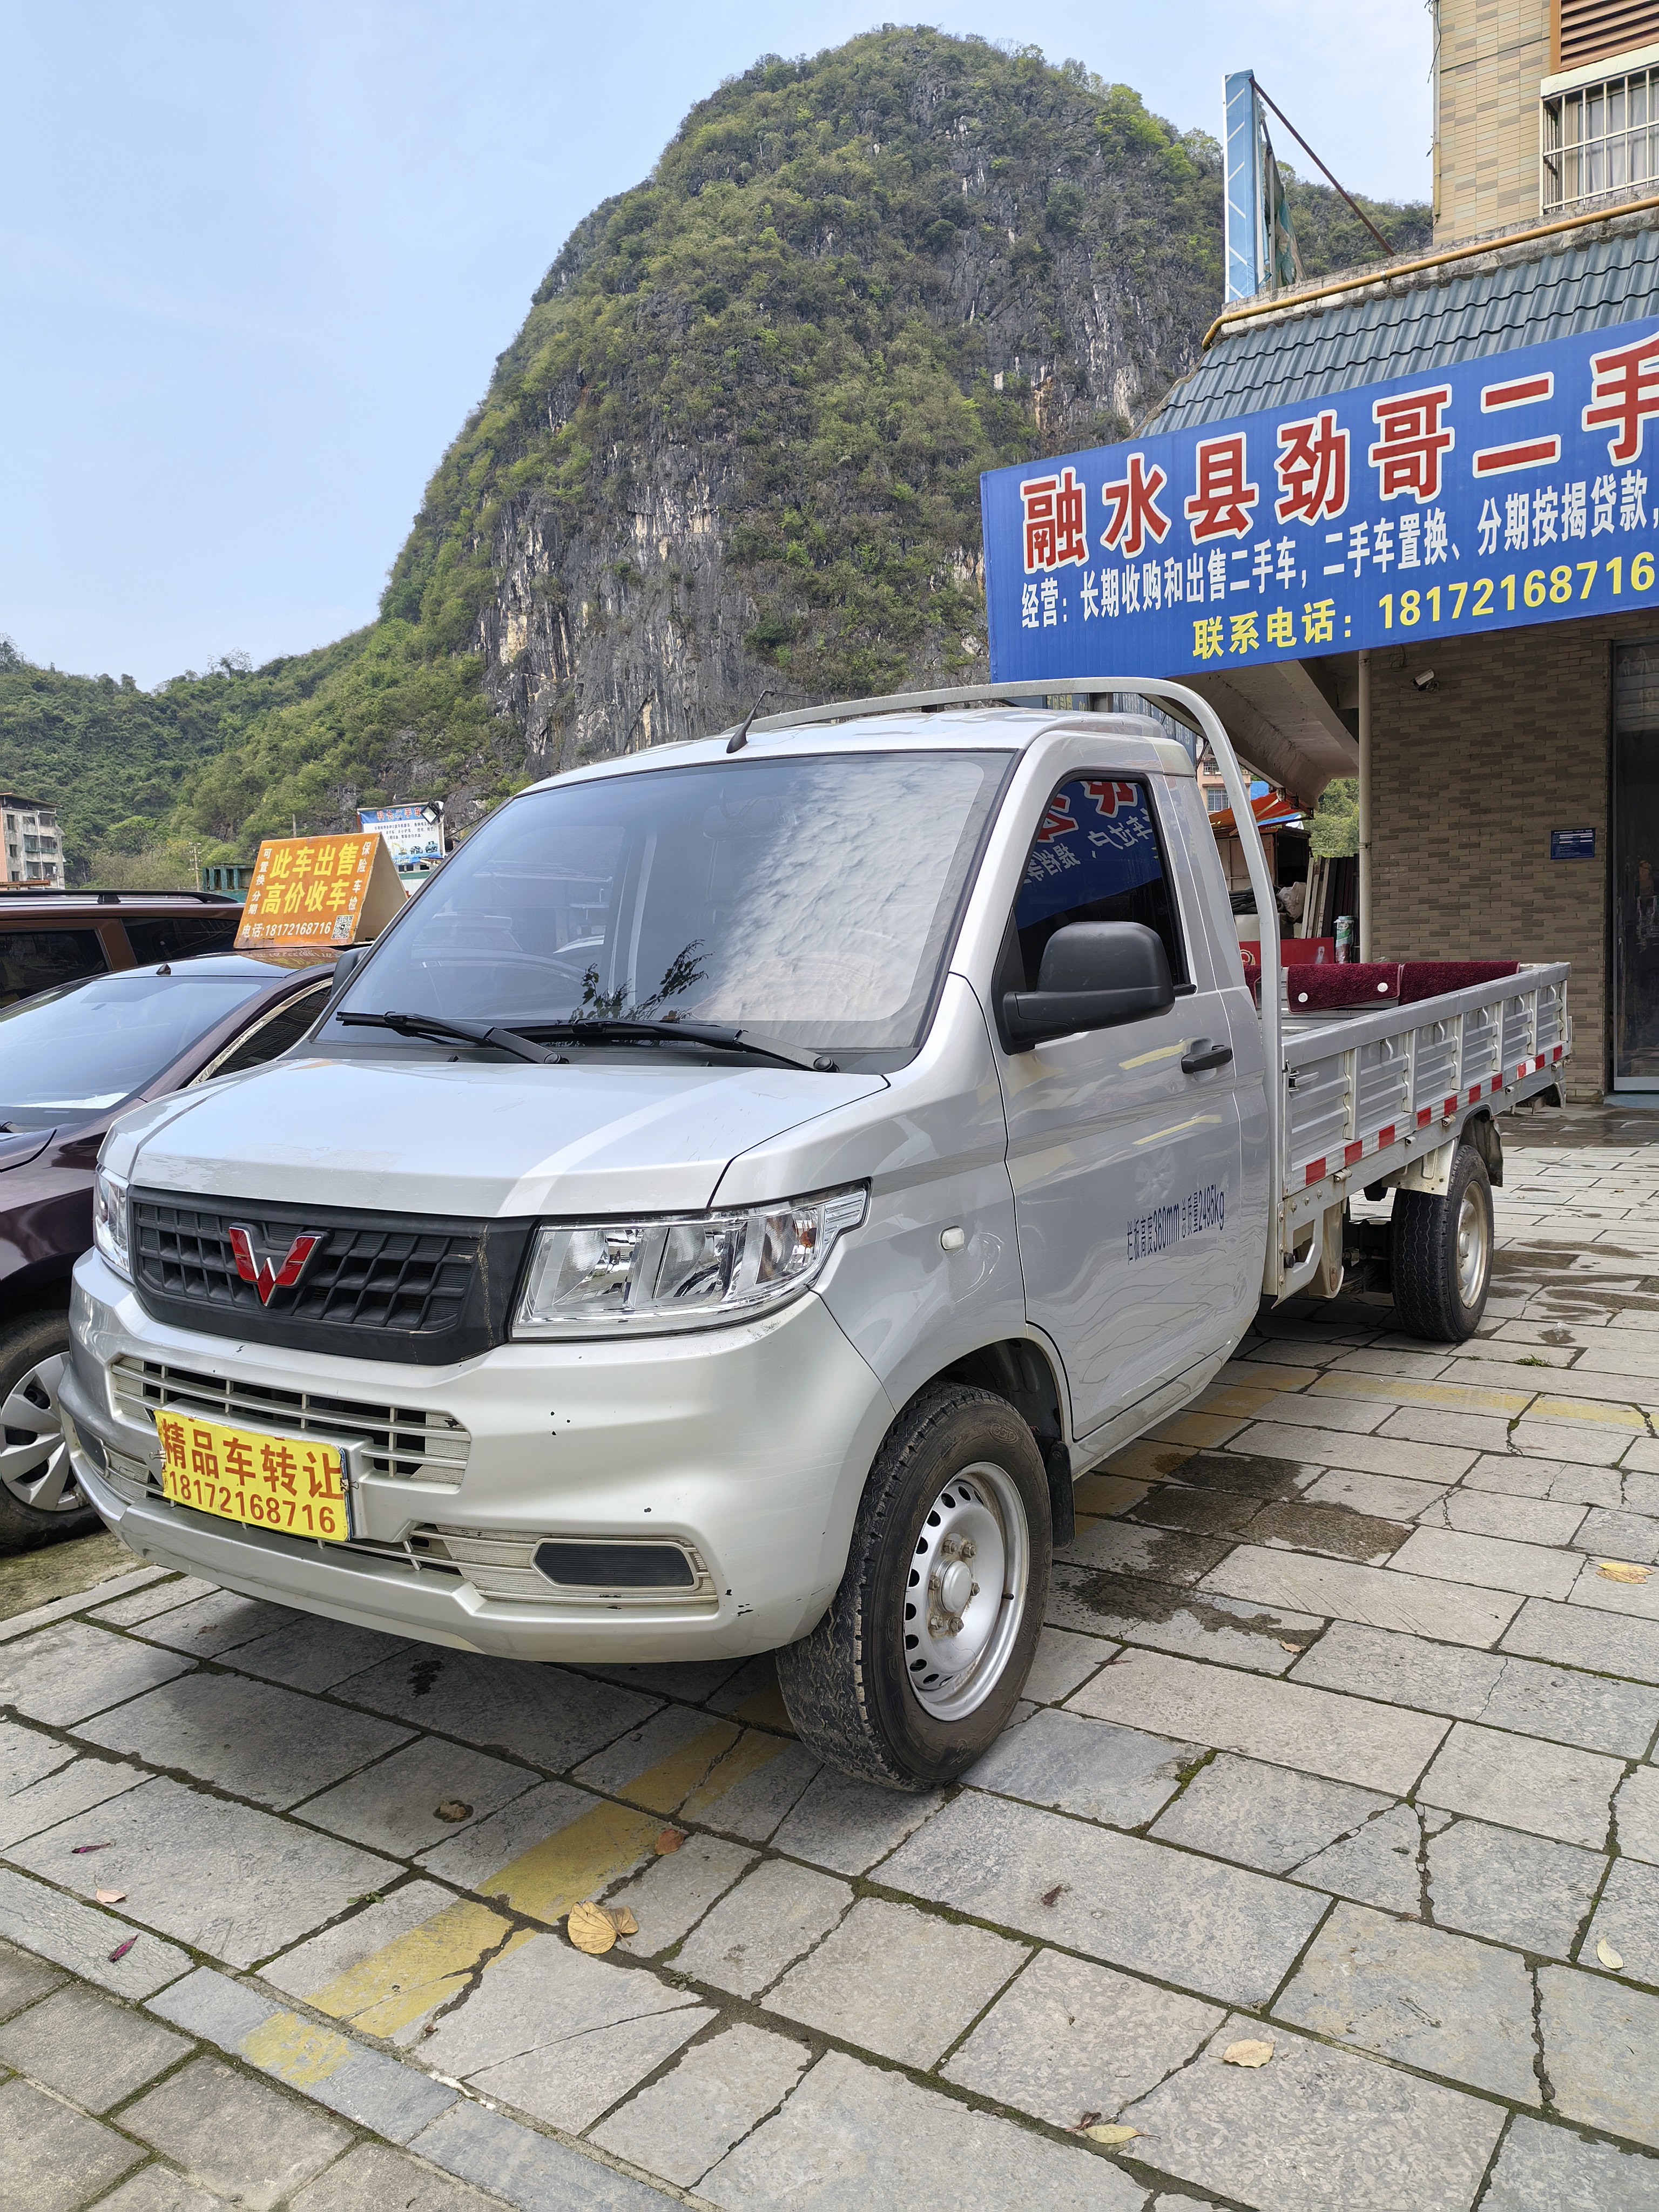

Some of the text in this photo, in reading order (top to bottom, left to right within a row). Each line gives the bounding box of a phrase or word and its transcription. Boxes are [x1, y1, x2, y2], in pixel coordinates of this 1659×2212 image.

[1020, 331, 1659, 574] 融水县劲哥二手
[269, 842, 359, 879] 此车出售
[260, 879, 350, 914] 高价收车
[163, 1419, 343, 1500] 精品车转让
[169, 1471, 335, 1534] 18172168716
